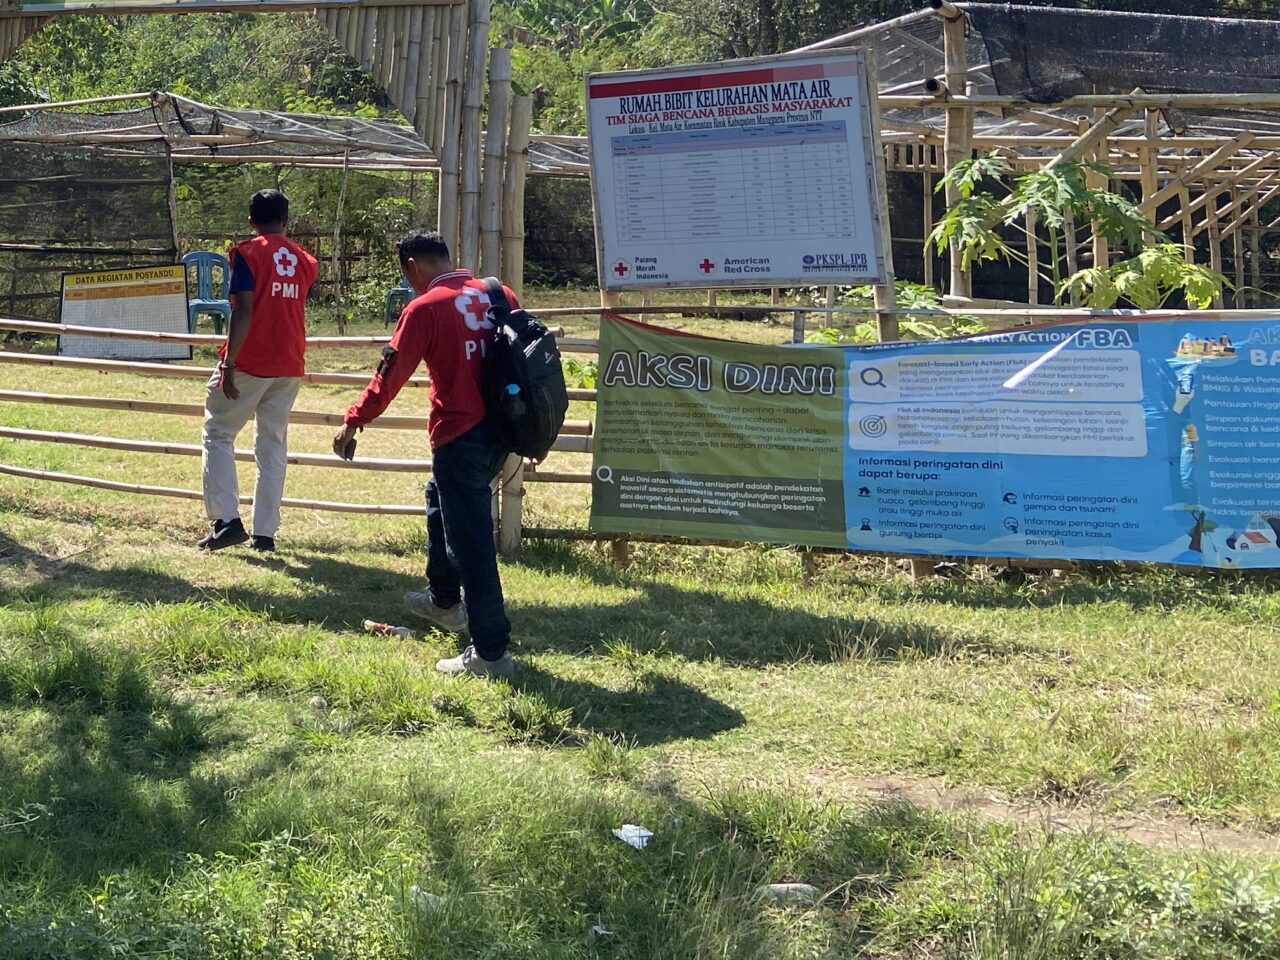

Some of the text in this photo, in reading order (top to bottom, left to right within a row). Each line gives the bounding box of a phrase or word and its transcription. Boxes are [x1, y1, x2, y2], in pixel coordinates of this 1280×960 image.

[620, 80, 832, 114] RUMAH BIBIT KELURAHAN MATA AIR
[606, 97, 852, 125] TIM SIAGA BENCANA BERBASIS MASYARAKAT
[660, 123, 672, 132] Mata
[810, 110, 822, 120] NTT
[635, 256, 657, 264] Palang
[724, 257, 770, 265] American
[816, 254, 867, 265] PKSPL-IPB
[76, 270, 174, 284] DATA KEGIATAN POSYANDU
[272, 282, 299, 299] PMI
[1018, 328, 1133, 349] ACTION FBA
[604, 351, 834, 394] AKSI DINI
[1202, 375, 1254, 383] Melakukan
[1204, 400, 1251, 408] Pantauan
[783, 407, 809, 416] dapat
[1205, 415, 1241, 423] Simpan
[1206, 424, 1248, 432] bencana
[1208, 440, 1243, 448] Simpan
[858, 458, 1003, 471] Informasi peringatan dini
[858, 469, 941, 482] dapat berupa:
[670, 478, 704, 486] tindakan
[705, 482, 744, 490] antisipatif
[774, 484, 823, 492] pendekatan
[675, 488, 713, 496] sistematis
[714, 490, 780, 502] menghubungkan
[781, 494, 826, 503] peringatan
[877, 487, 900, 496] Banjir
[935, 489, 977, 498] prakiraan
[703, 498, 746, 508] melindungi
[747, 502, 781, 511] keluarga
[783, 503, 814, 511] beserta
[909, 499, 985, 509] gelombang tinggi
[1066, 495, 1118, 504] peringatan
[1120, 496, 1137, 504] dini
[620, 502, 648, 510] asetnya
[1024, 504, 1056, 512] gempa
[900, 508, 924, 517] tinggi
[878, 520, 986, 531] Informasi peringatan dini
[1024, 518, 1066, 526] Informasi
[1068, 520, 1120, 529] peringatan
[879, 531, 912, 539] gunung
[1025, 528, 1083, 537] peningkatan
[1026, 538, 1064, 547] penyakit
